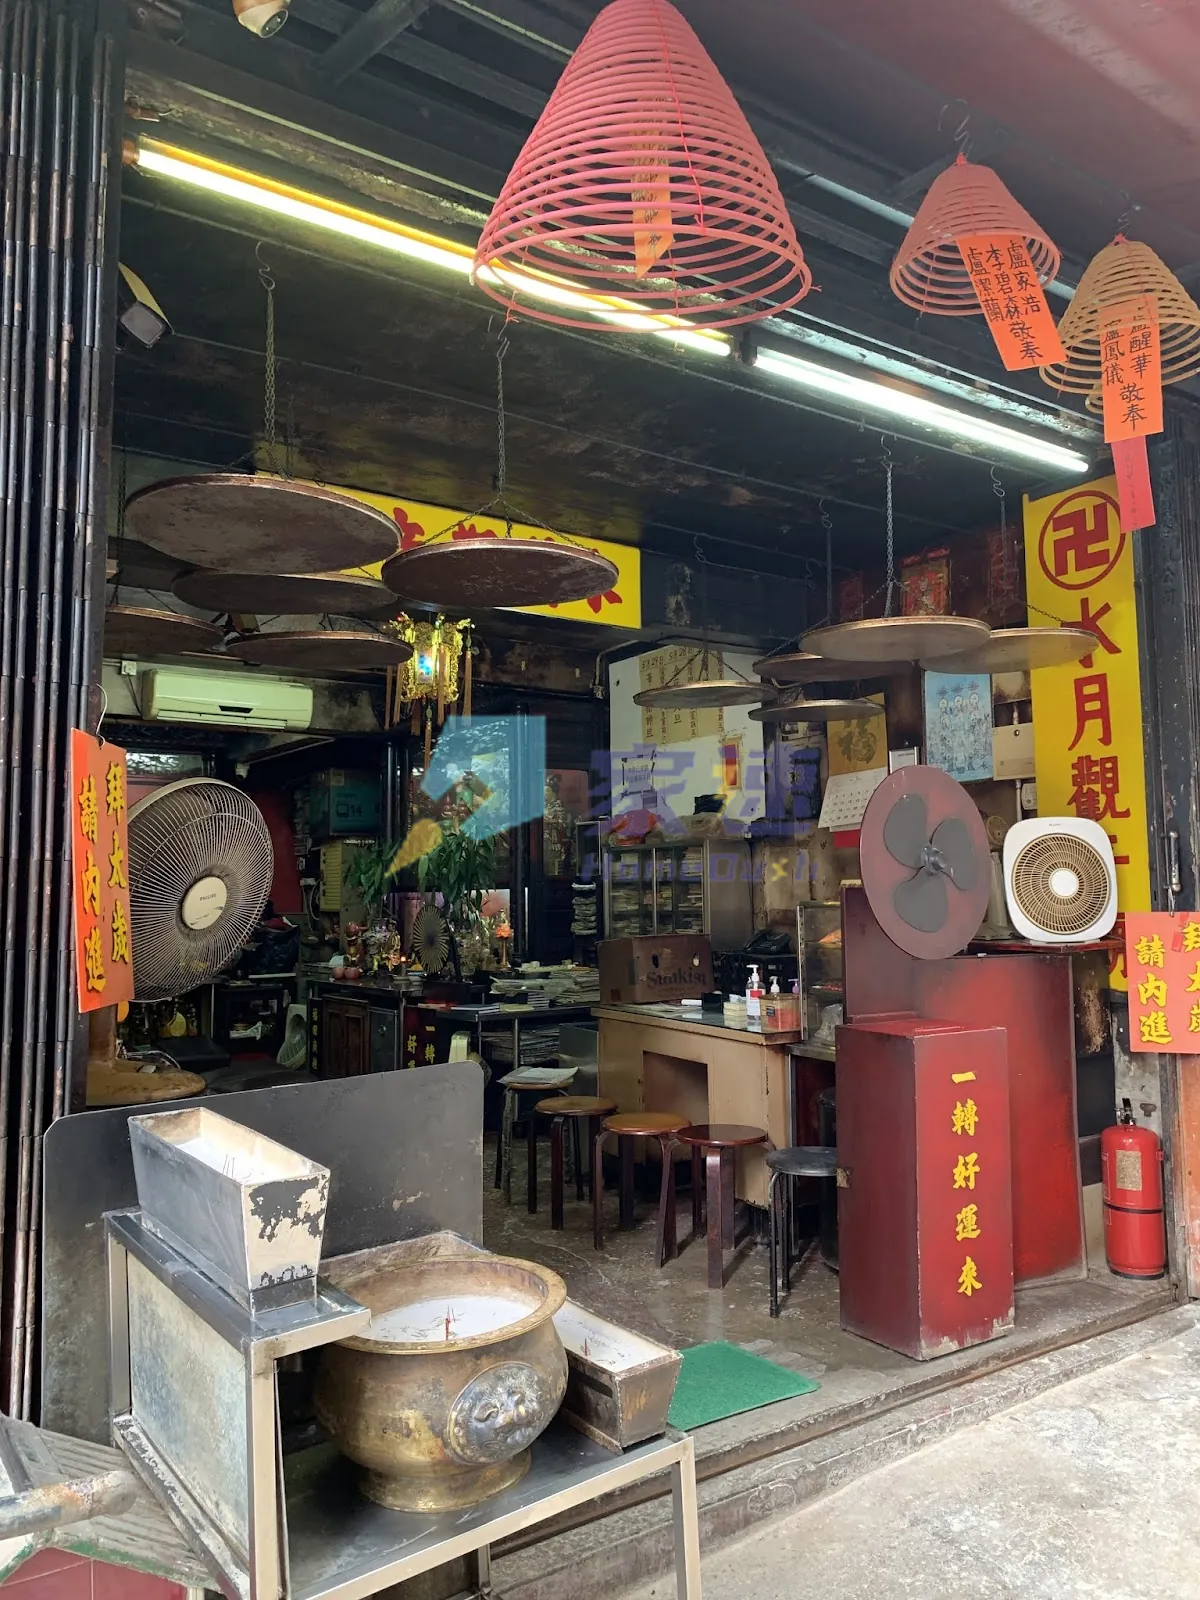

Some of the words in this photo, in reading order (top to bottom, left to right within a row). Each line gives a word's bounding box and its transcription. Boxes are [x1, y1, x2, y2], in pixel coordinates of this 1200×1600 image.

[1007, 240, 1041, 315] 盧家浩
[1119, 382, 1148, 432] 敬奉
[106, 760, 130, 965] 拜太歲
[951, 1071, 983, 1297] 一轉好運來
